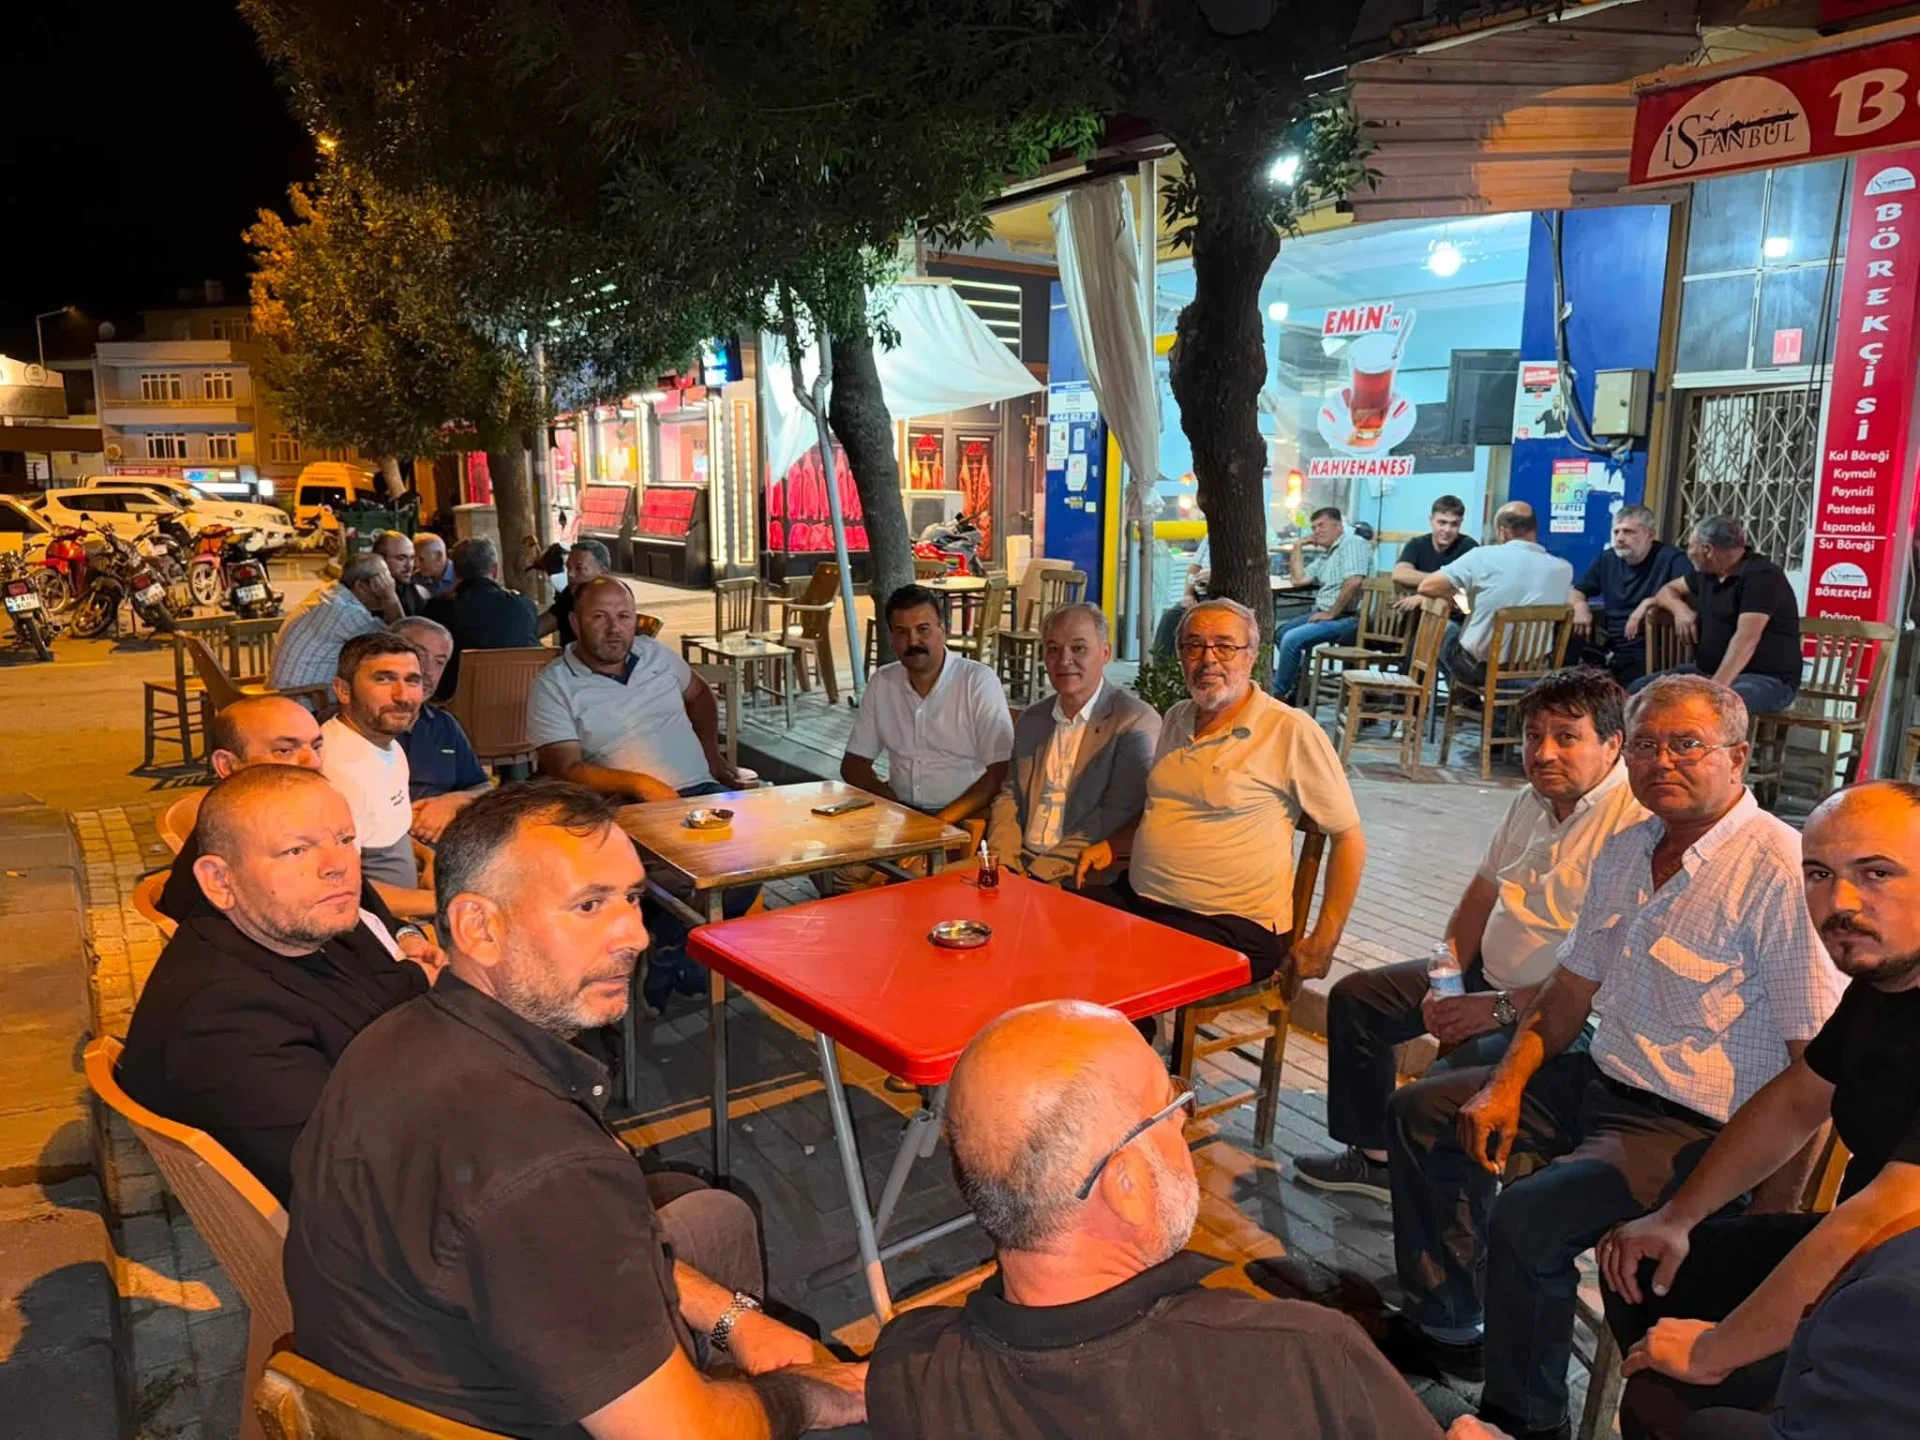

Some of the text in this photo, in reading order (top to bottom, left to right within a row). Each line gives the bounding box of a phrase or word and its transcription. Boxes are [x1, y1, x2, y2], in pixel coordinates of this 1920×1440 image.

[1828, 449, 1890, 463] Kol Böreği
[1311, 456, 1413, 477] KAHVEHANESİ
[1833, 468, 1877, 481] Kıymalı
[1831, 486, 1875, 499] Peynirli
[1822, 521, 1875, 533] Ispanaklı
[1818, 538, 1876, 553] Su Böreği
